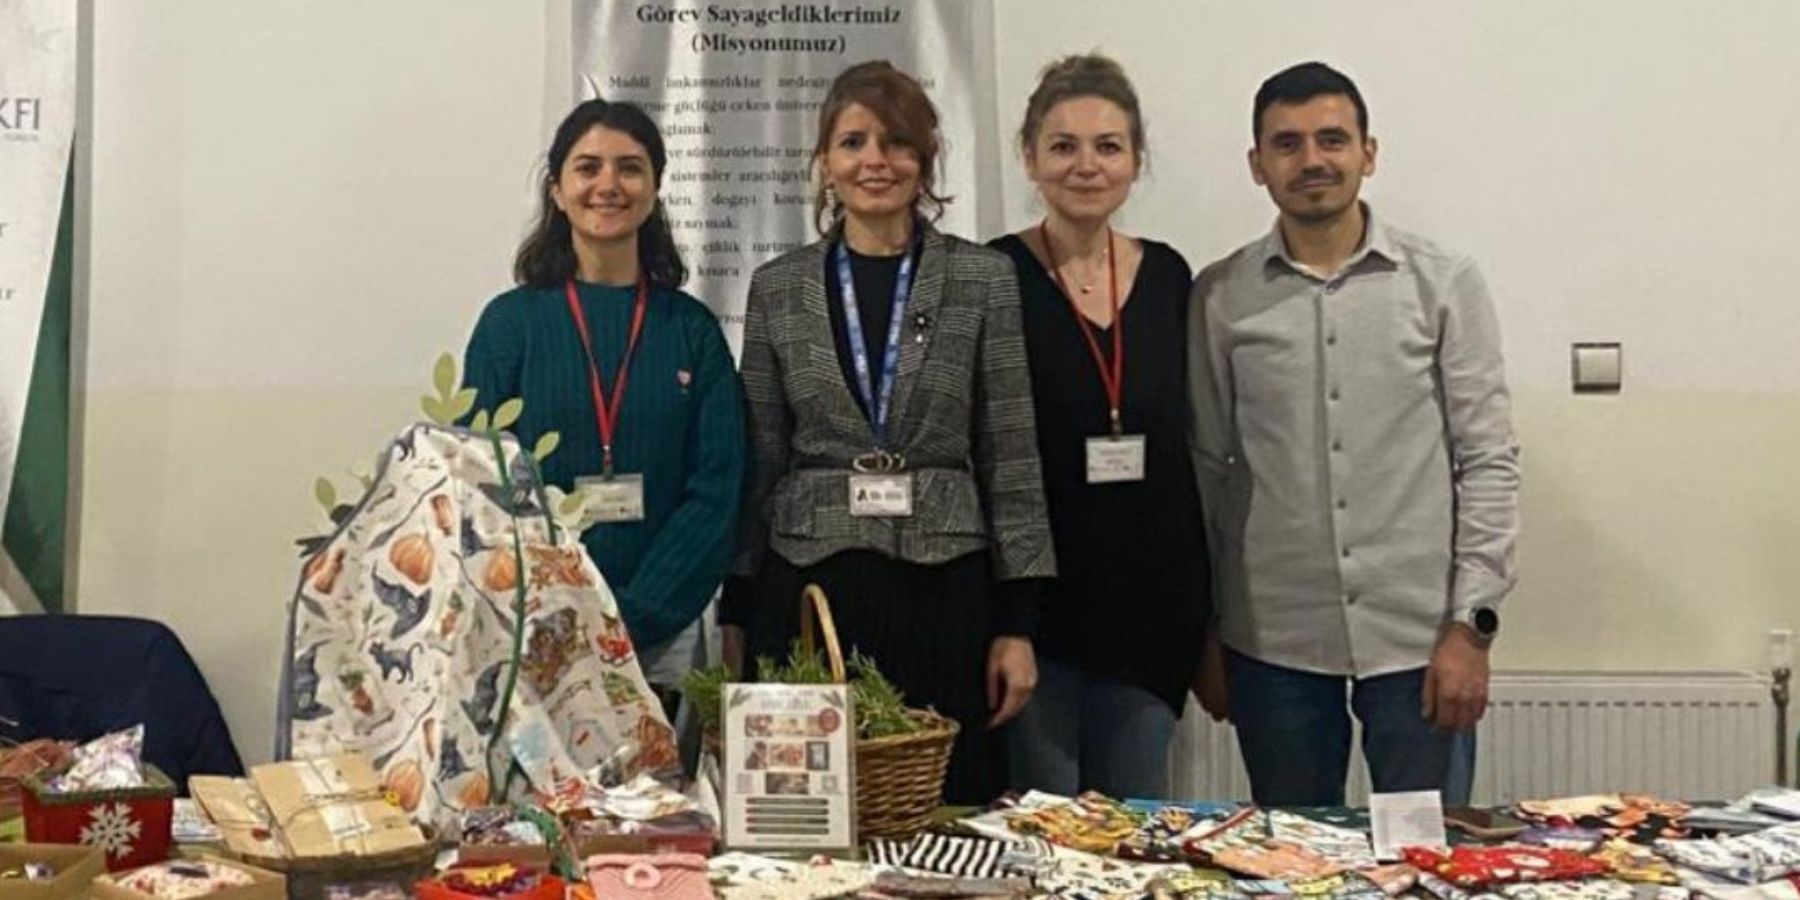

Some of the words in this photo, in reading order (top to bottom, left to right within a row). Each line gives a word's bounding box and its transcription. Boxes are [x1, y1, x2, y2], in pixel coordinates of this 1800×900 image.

[636, 4, 700, 23] Görev
[706, 4, 901, 26] Sayageldiklerimiz
[691, 33, 846, 55] (Misyonumuz)
